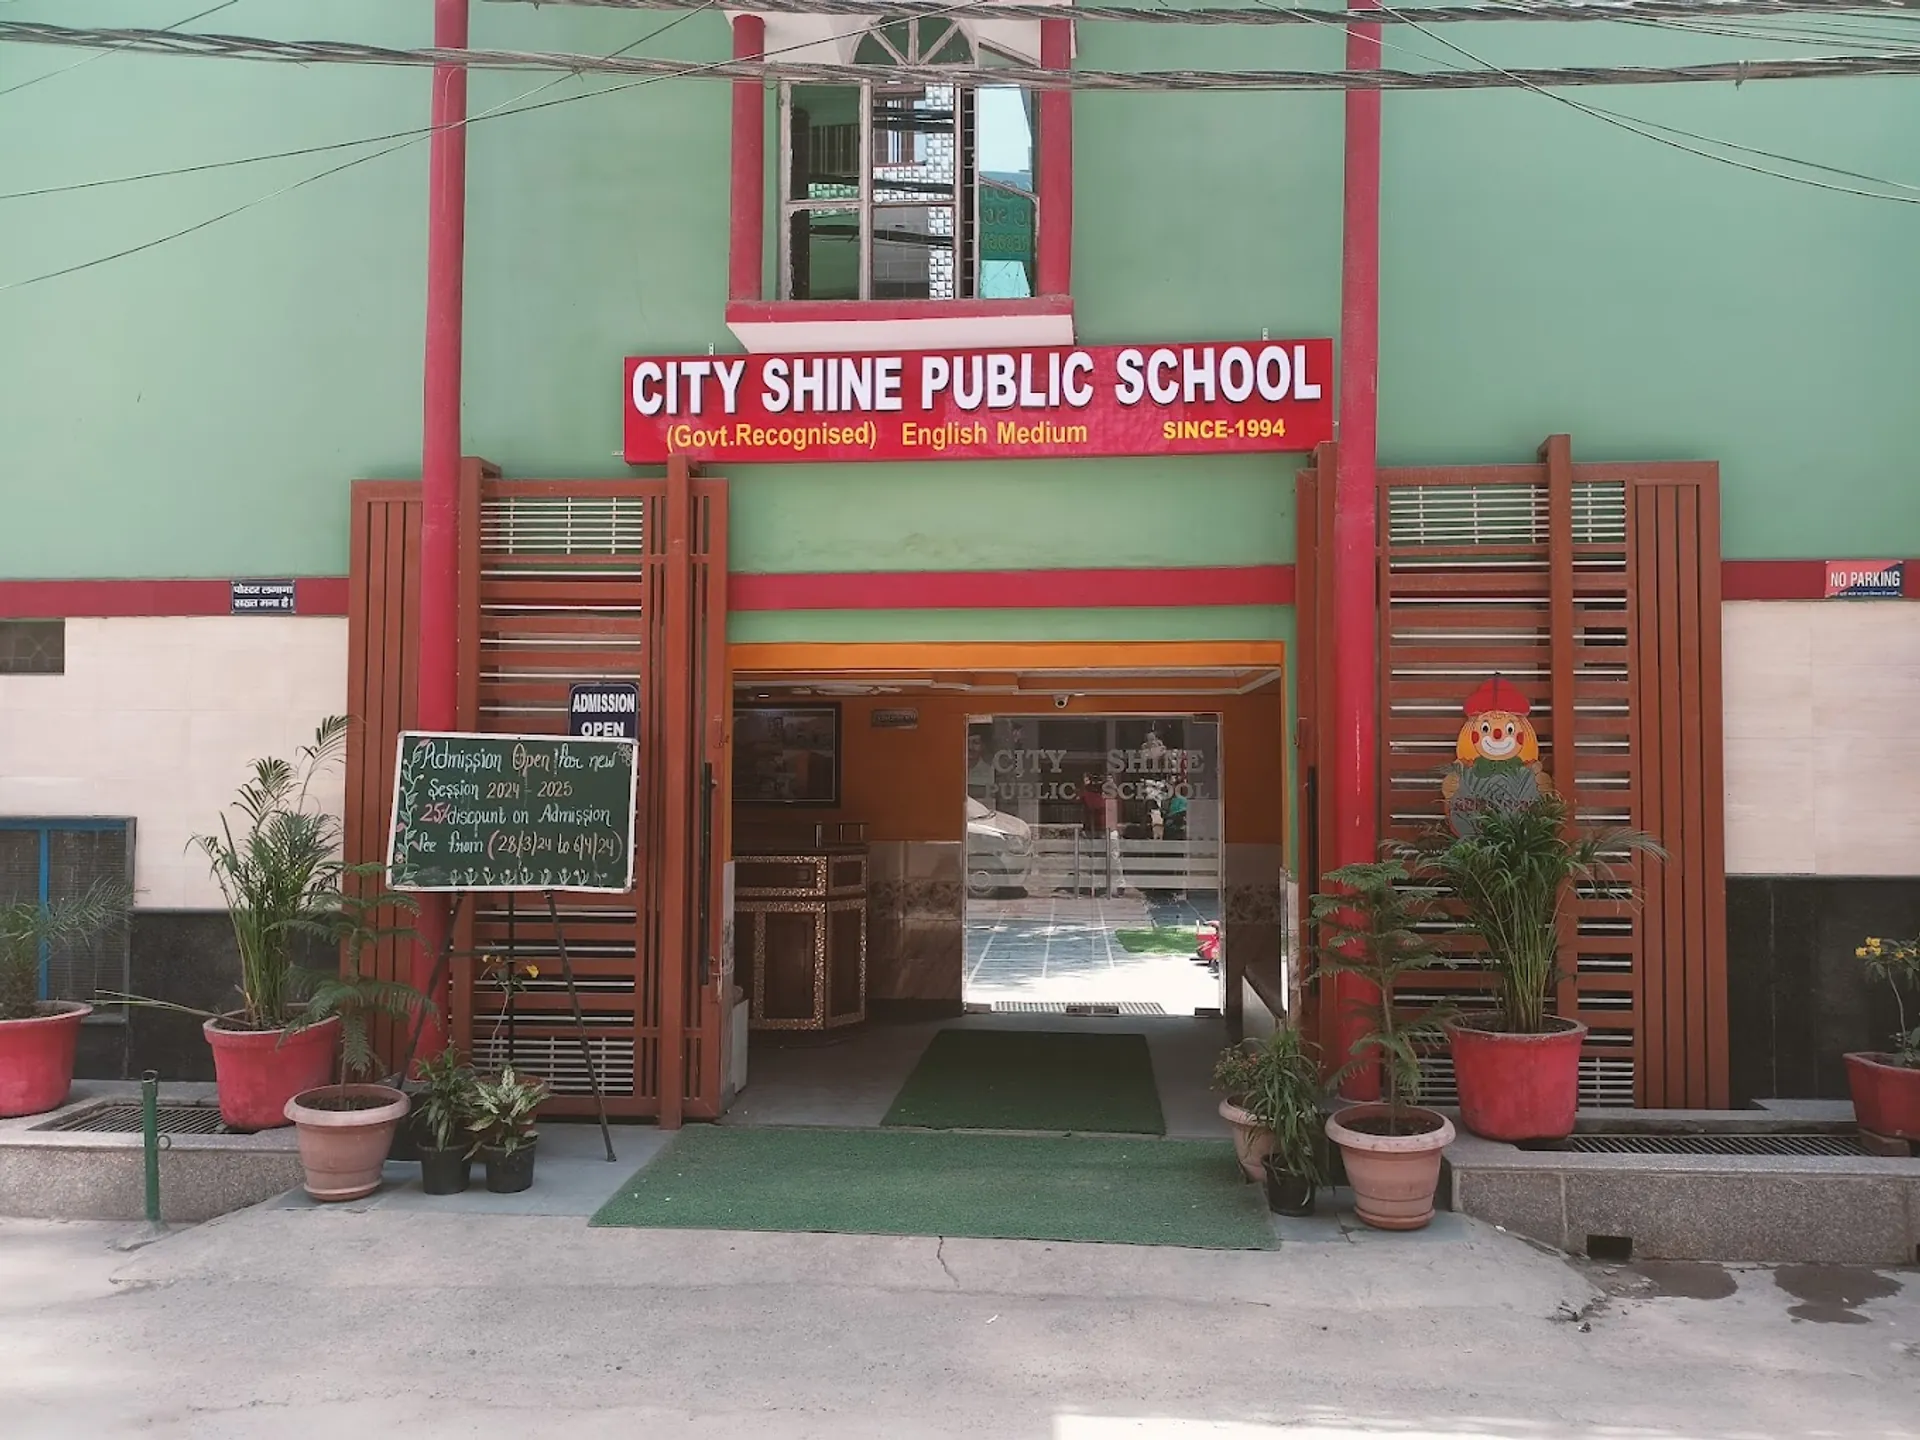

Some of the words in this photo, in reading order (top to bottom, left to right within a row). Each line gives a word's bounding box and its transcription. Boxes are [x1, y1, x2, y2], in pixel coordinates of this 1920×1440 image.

[632, 360, 746, 414] CITY
[761, 357, 903, 412] SHINE
[921, 351, 1094, 410] PUBLIC
[1115, 345, 1322, 405] SCHOOL
[667, 421, 877, 452] (Govt.Recognised)
[902, 421, 987, 449] English
[997, 421, 1087, 445] Medium
[1163, 419, 1286, 440] SINCE-1994
[1831, 571, 1847, 587] NO
[1850, 571, 1900, 587] PARKING
[572, 693, 635, 713] ADMISSION
[581, 721, 625, 737] OPEN
[420, 741, 502, 773] Admission
[513, 743, 550, 776] Open
[559, 743, 584, 769] for
[589, 752, 617, 772] new
[993, 749, 1067, 773] CITY
[1107, 749, 1204, 773] SHINE
[428, 778, 479, 801] Session
[486, 782, 520, 799] 2024
[537, 781, 573, 797] 2025
[985, 782, 1076, 800] PUBLIC
[513, 810, 529, 824] on
[537, 803, 612, 827] Admission
[448, 830, 484, 853] from
[557, 832, 570, 854] to
